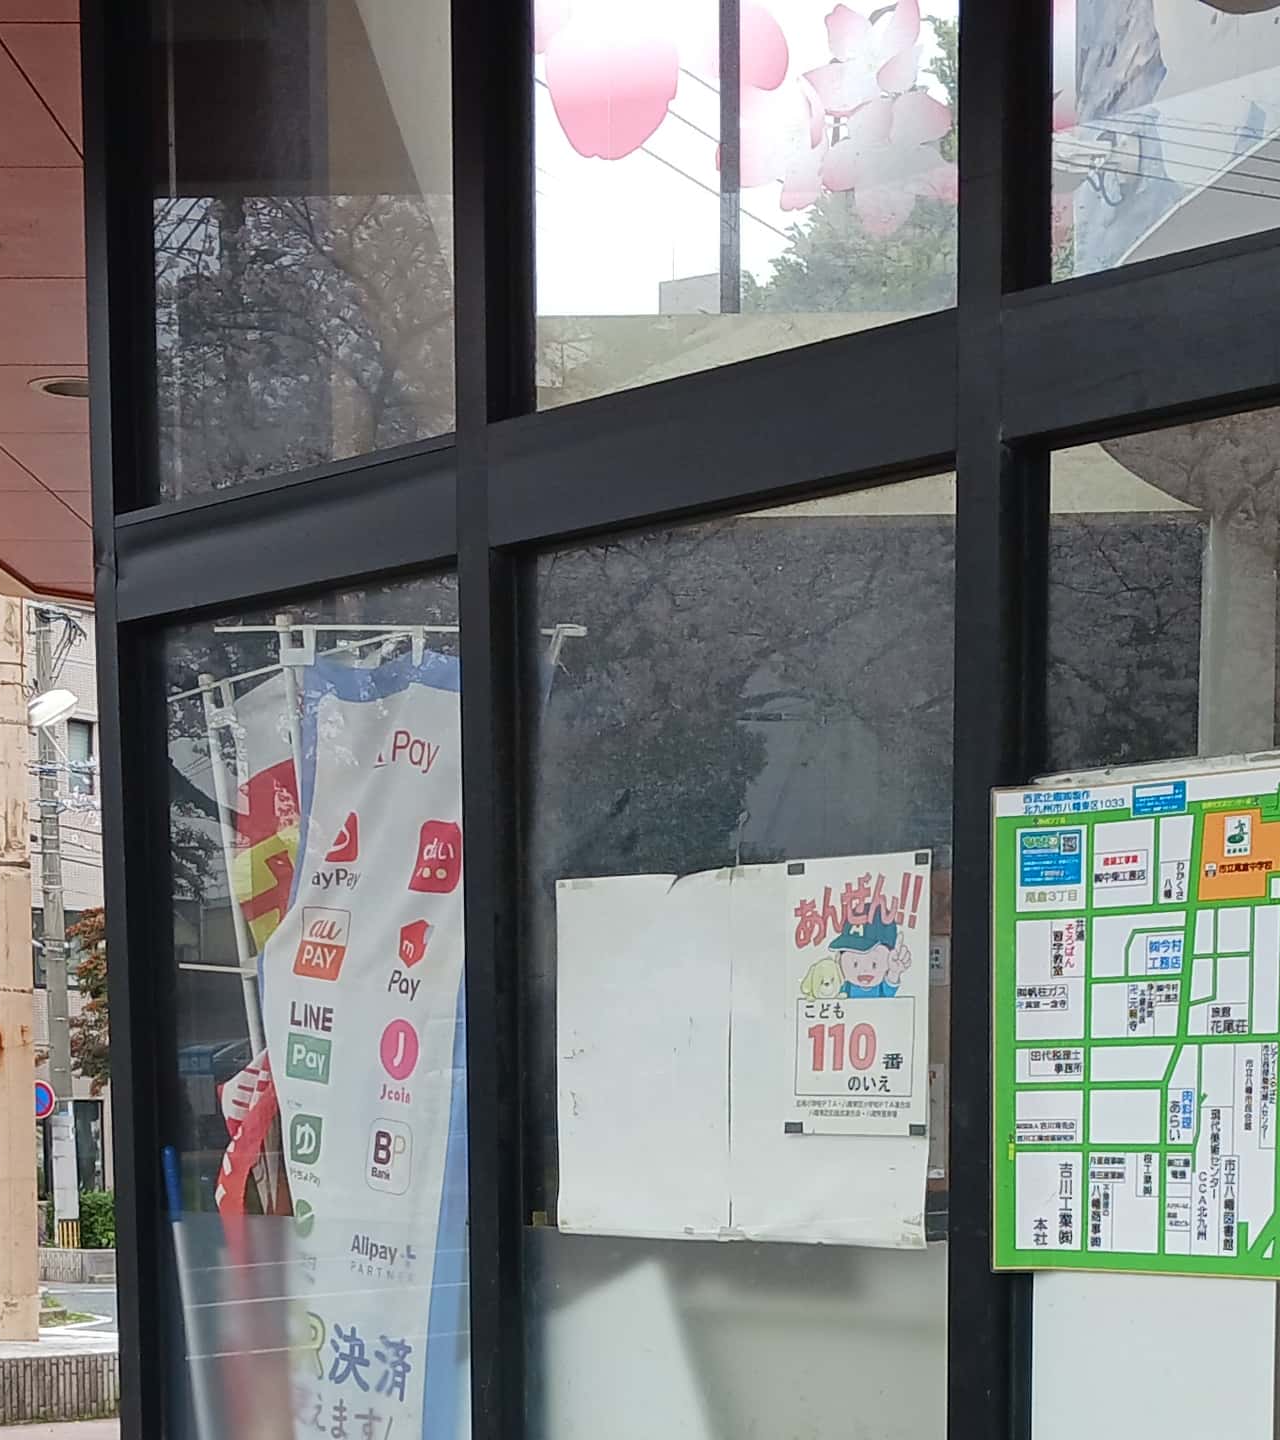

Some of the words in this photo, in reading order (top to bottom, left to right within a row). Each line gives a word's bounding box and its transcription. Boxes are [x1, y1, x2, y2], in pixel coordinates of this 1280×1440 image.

[392, 730, 440, 774] Pay
[1175, 862, 1185, 900] わかくさ
[793, 871, 924, 949] あんぜん!!
[302, 944, 337, 969] PAY
[1064, 923, 1075, 968] そろばん
[387, 969, 422, 1001] Pay
[289, 1001, 334, 1032] LINE
[804, 1002, 845, 1019] こども
[291, 1043, 326, 1076] Pay
[808, 1023, 877, 1072] 110
[882, 1052, 904, 1070] 番
[847, 1075, 892, 1093] のいえ
[1169, 1101, 1181, 1141] あらい
[1033, 1217, 1048, 1246] 本社
